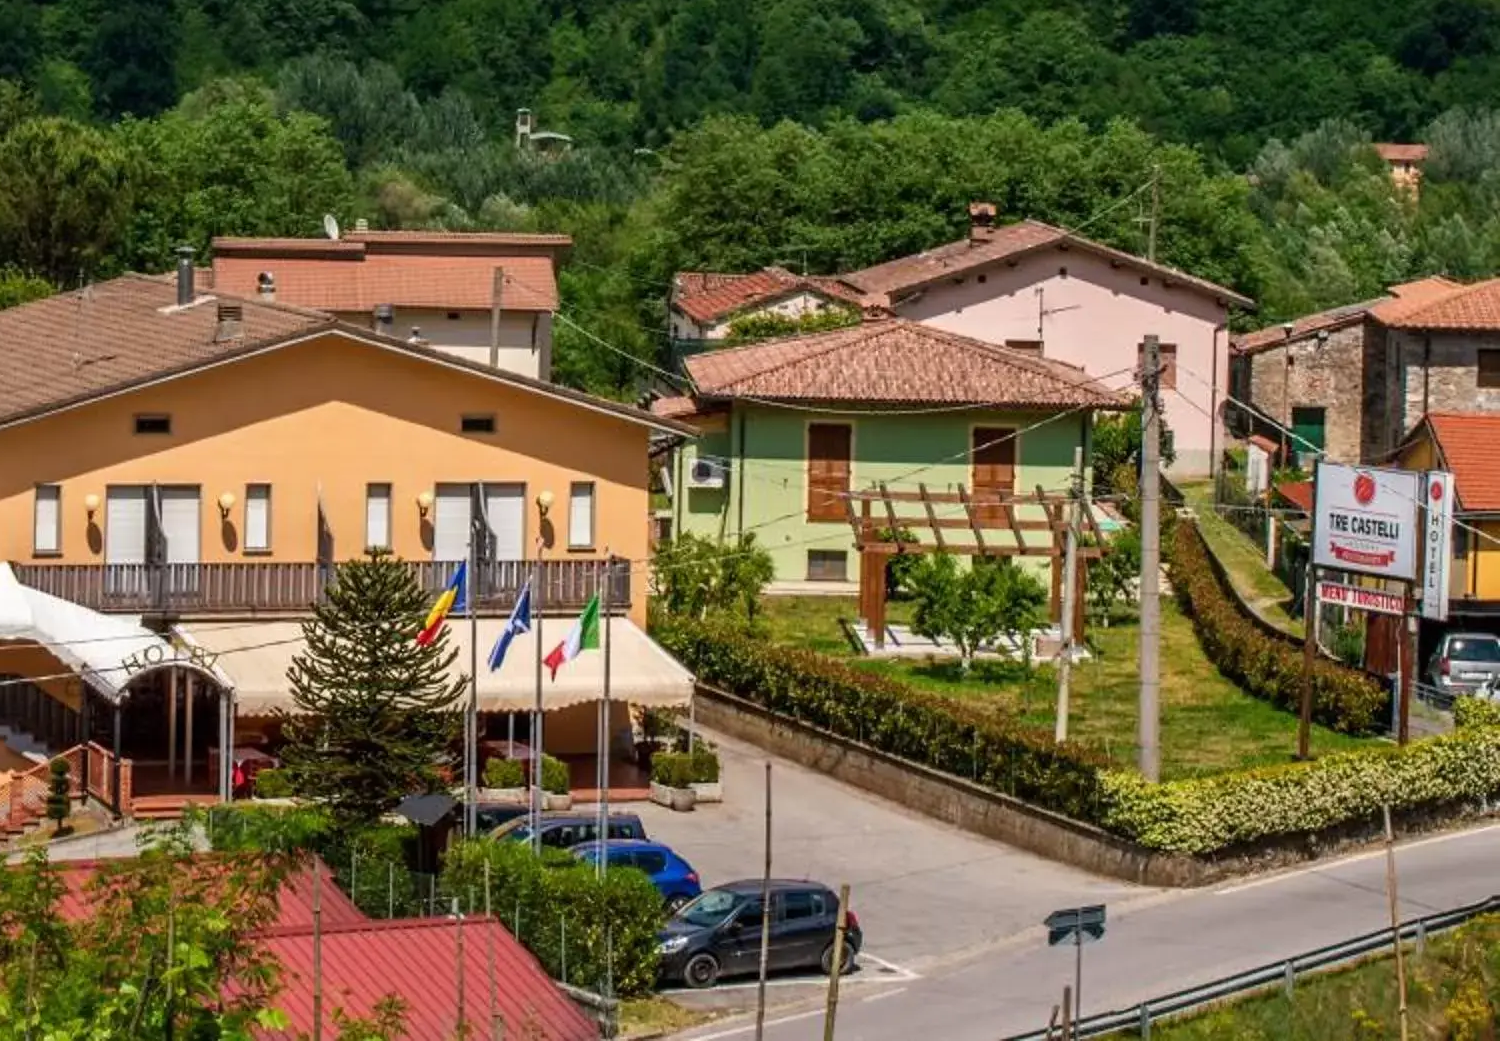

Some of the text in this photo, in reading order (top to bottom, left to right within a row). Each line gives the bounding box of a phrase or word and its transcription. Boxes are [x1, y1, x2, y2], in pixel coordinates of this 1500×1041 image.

[1329, 512, 1399, 540] TRE CASTELLI
[1429, 514, 1439, 588] HOTEL
